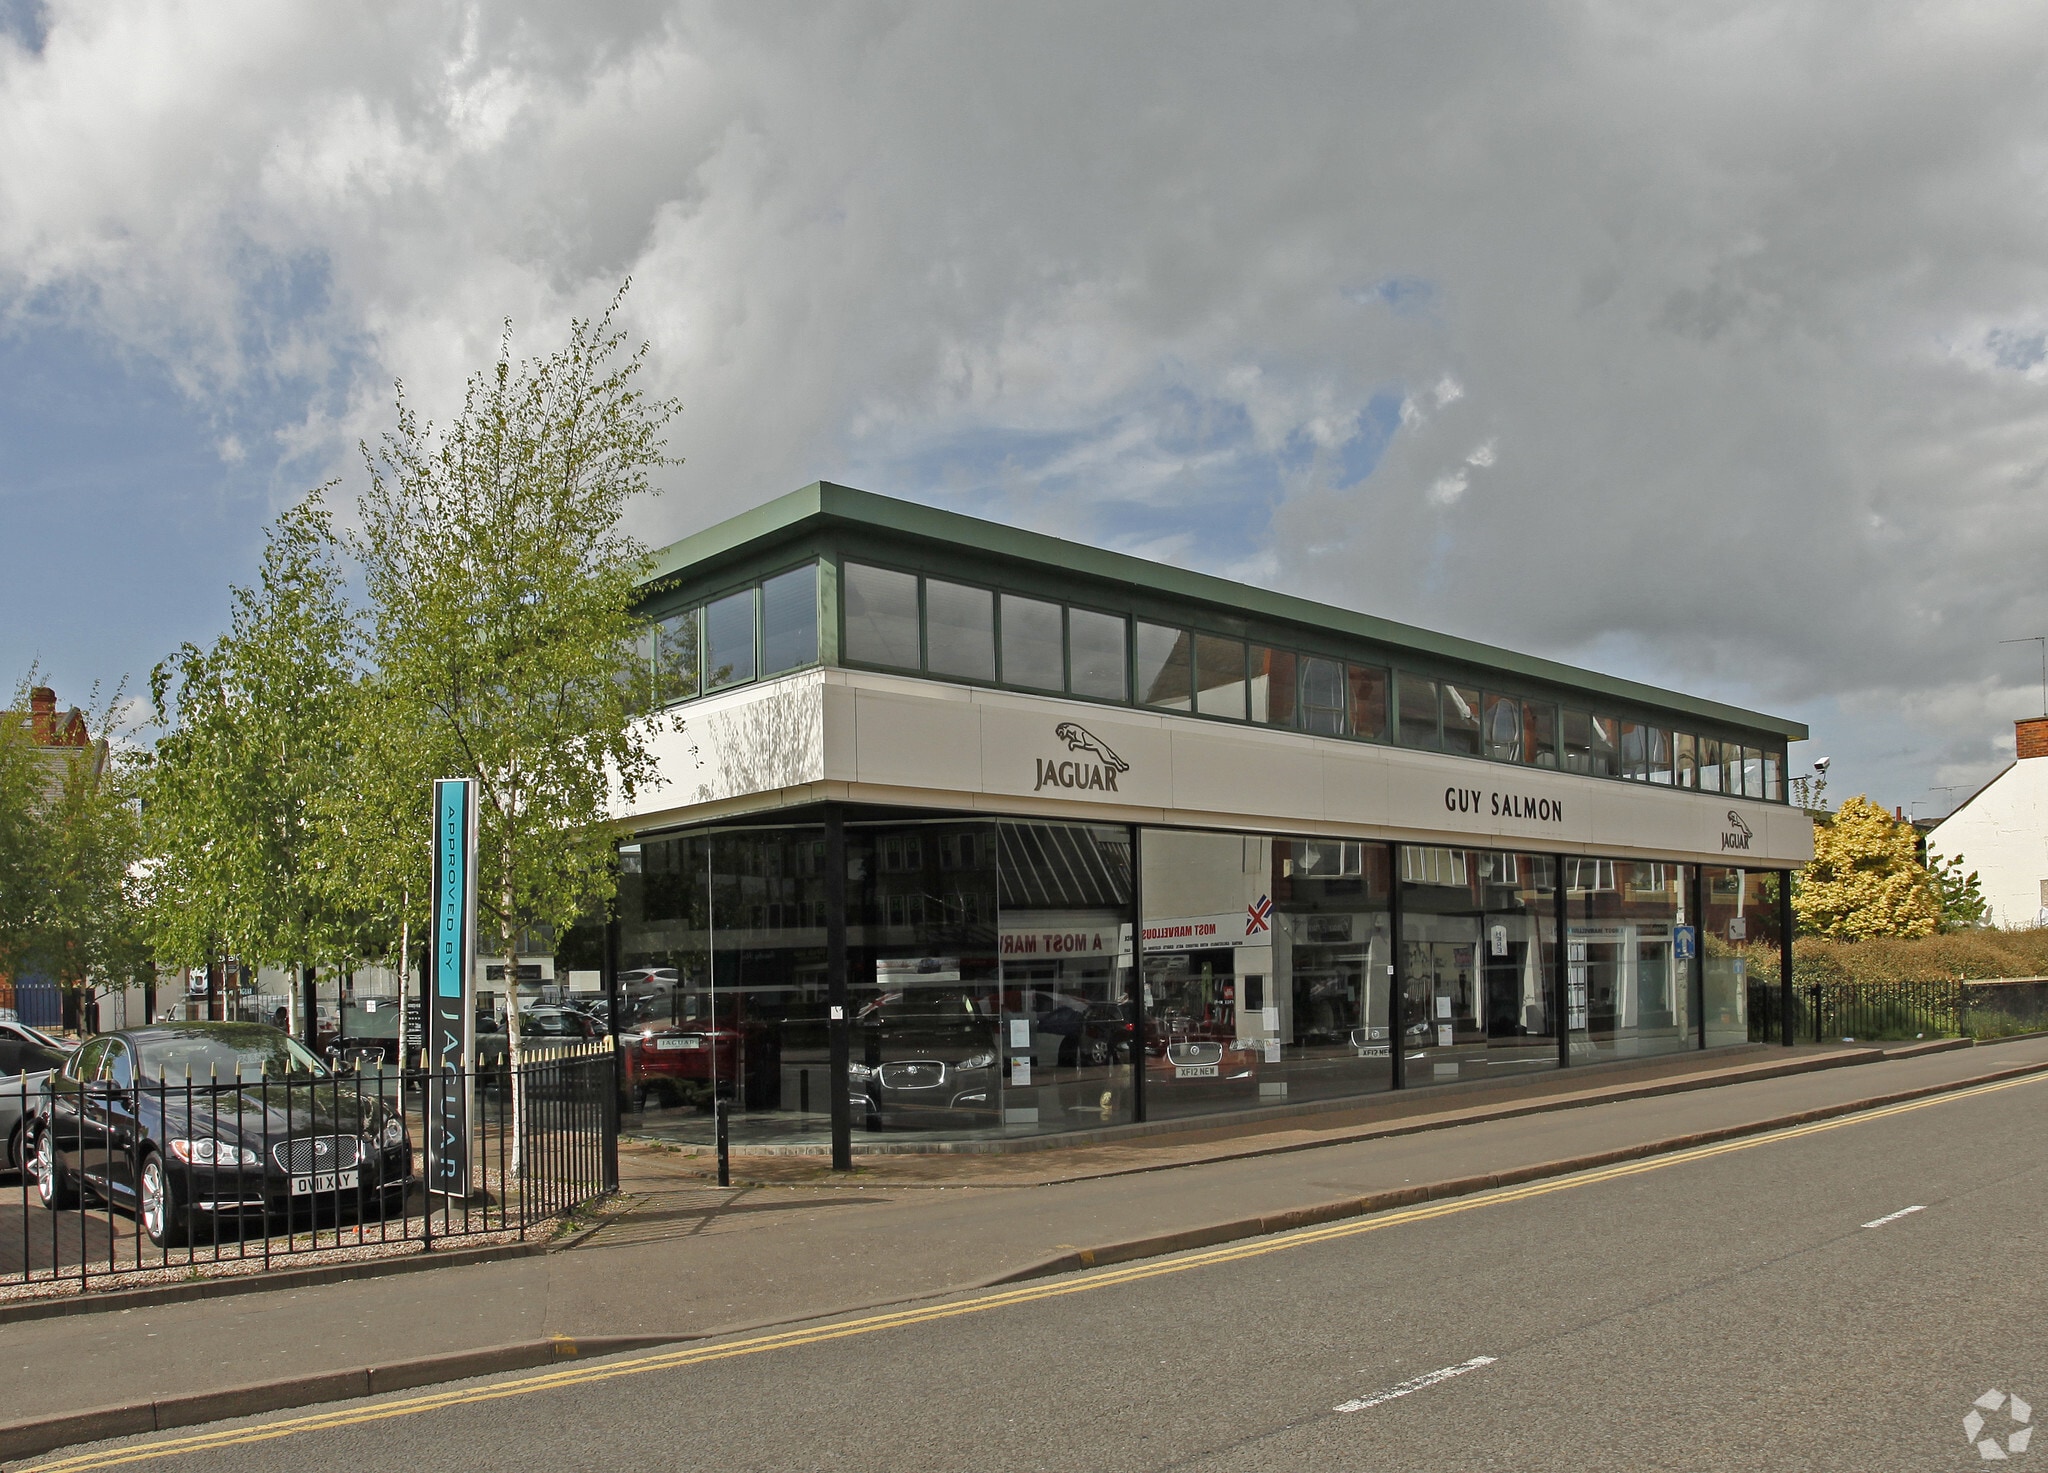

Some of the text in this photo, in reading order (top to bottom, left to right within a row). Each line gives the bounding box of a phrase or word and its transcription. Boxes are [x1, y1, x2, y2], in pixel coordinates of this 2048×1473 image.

[1034, 758, 1118, 792] JAGUAR
[1445, 787, 1562, 822] GUY SALMON
[1721, 832, 1749, 851] JAGUAR
[445, 806, 456, 971] APPROVED BY
[1181, 1067, 1214, 1076] XF12 NEW
[440, 1009, 459, 1178] JAGUAR
[327, 1174, 350, 1189] XY
